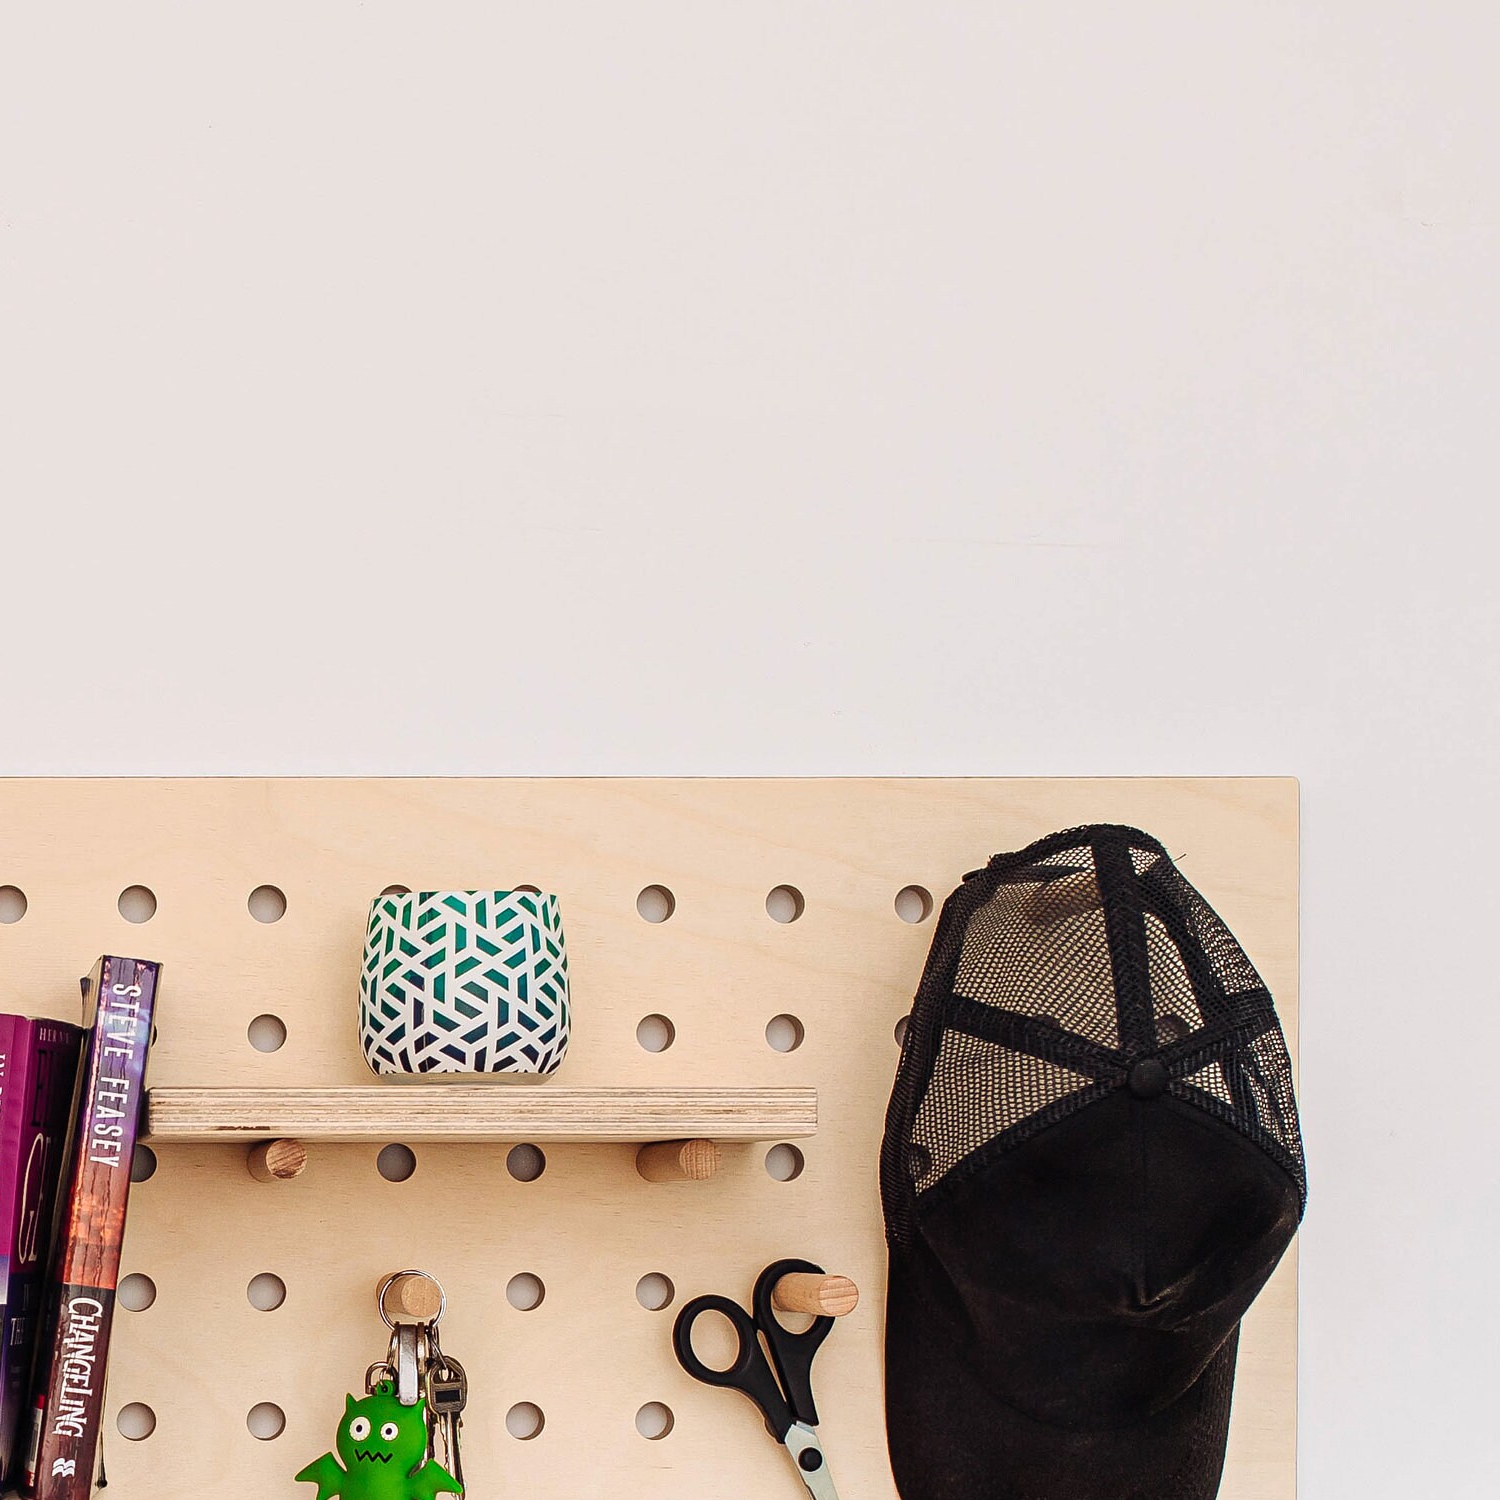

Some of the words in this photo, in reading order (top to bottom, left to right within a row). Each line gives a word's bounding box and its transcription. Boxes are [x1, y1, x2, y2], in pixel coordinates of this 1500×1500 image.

[104, 983, 142, 1060] STEVE
[89, 1076, 130, 1168] FEASEY
[52, 1297, 103, 1438] CHANGELING
